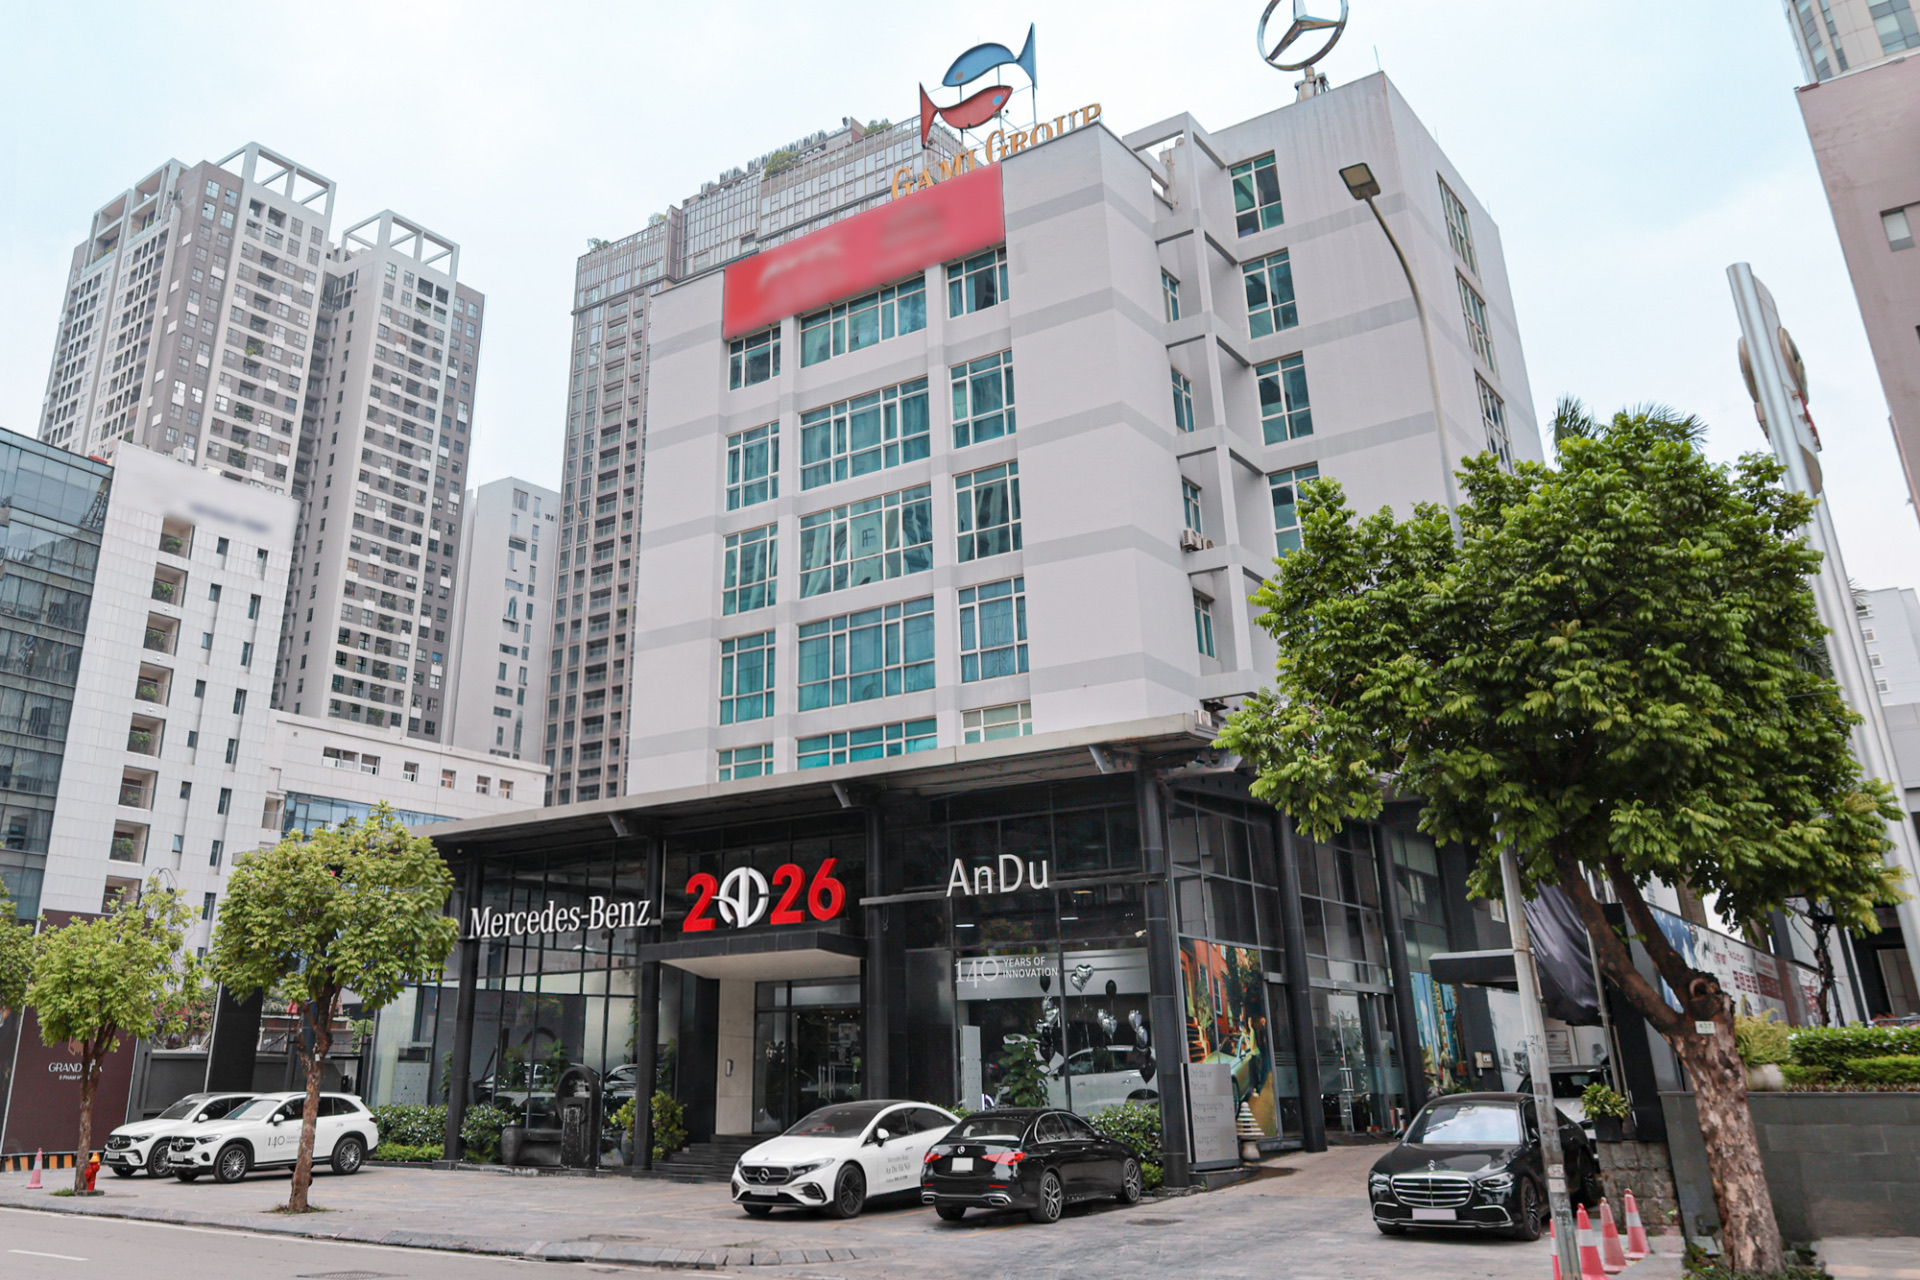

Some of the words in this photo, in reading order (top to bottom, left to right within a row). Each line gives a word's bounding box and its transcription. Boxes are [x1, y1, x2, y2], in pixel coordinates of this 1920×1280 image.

[891, 148, 978, 201] GAMI
[986, 103, 1101, 165] GROUP
[946, 853, 1049, 897] AnDu
[469, 895, 651, 940] Mercedes-Benz
[954, 958, 999, 988] 140
[1003, 957, 1031, 967] YEARS
[1033, 956, 1046, 966] OF
[1003, 967, 1058, 979] INNOVATION
